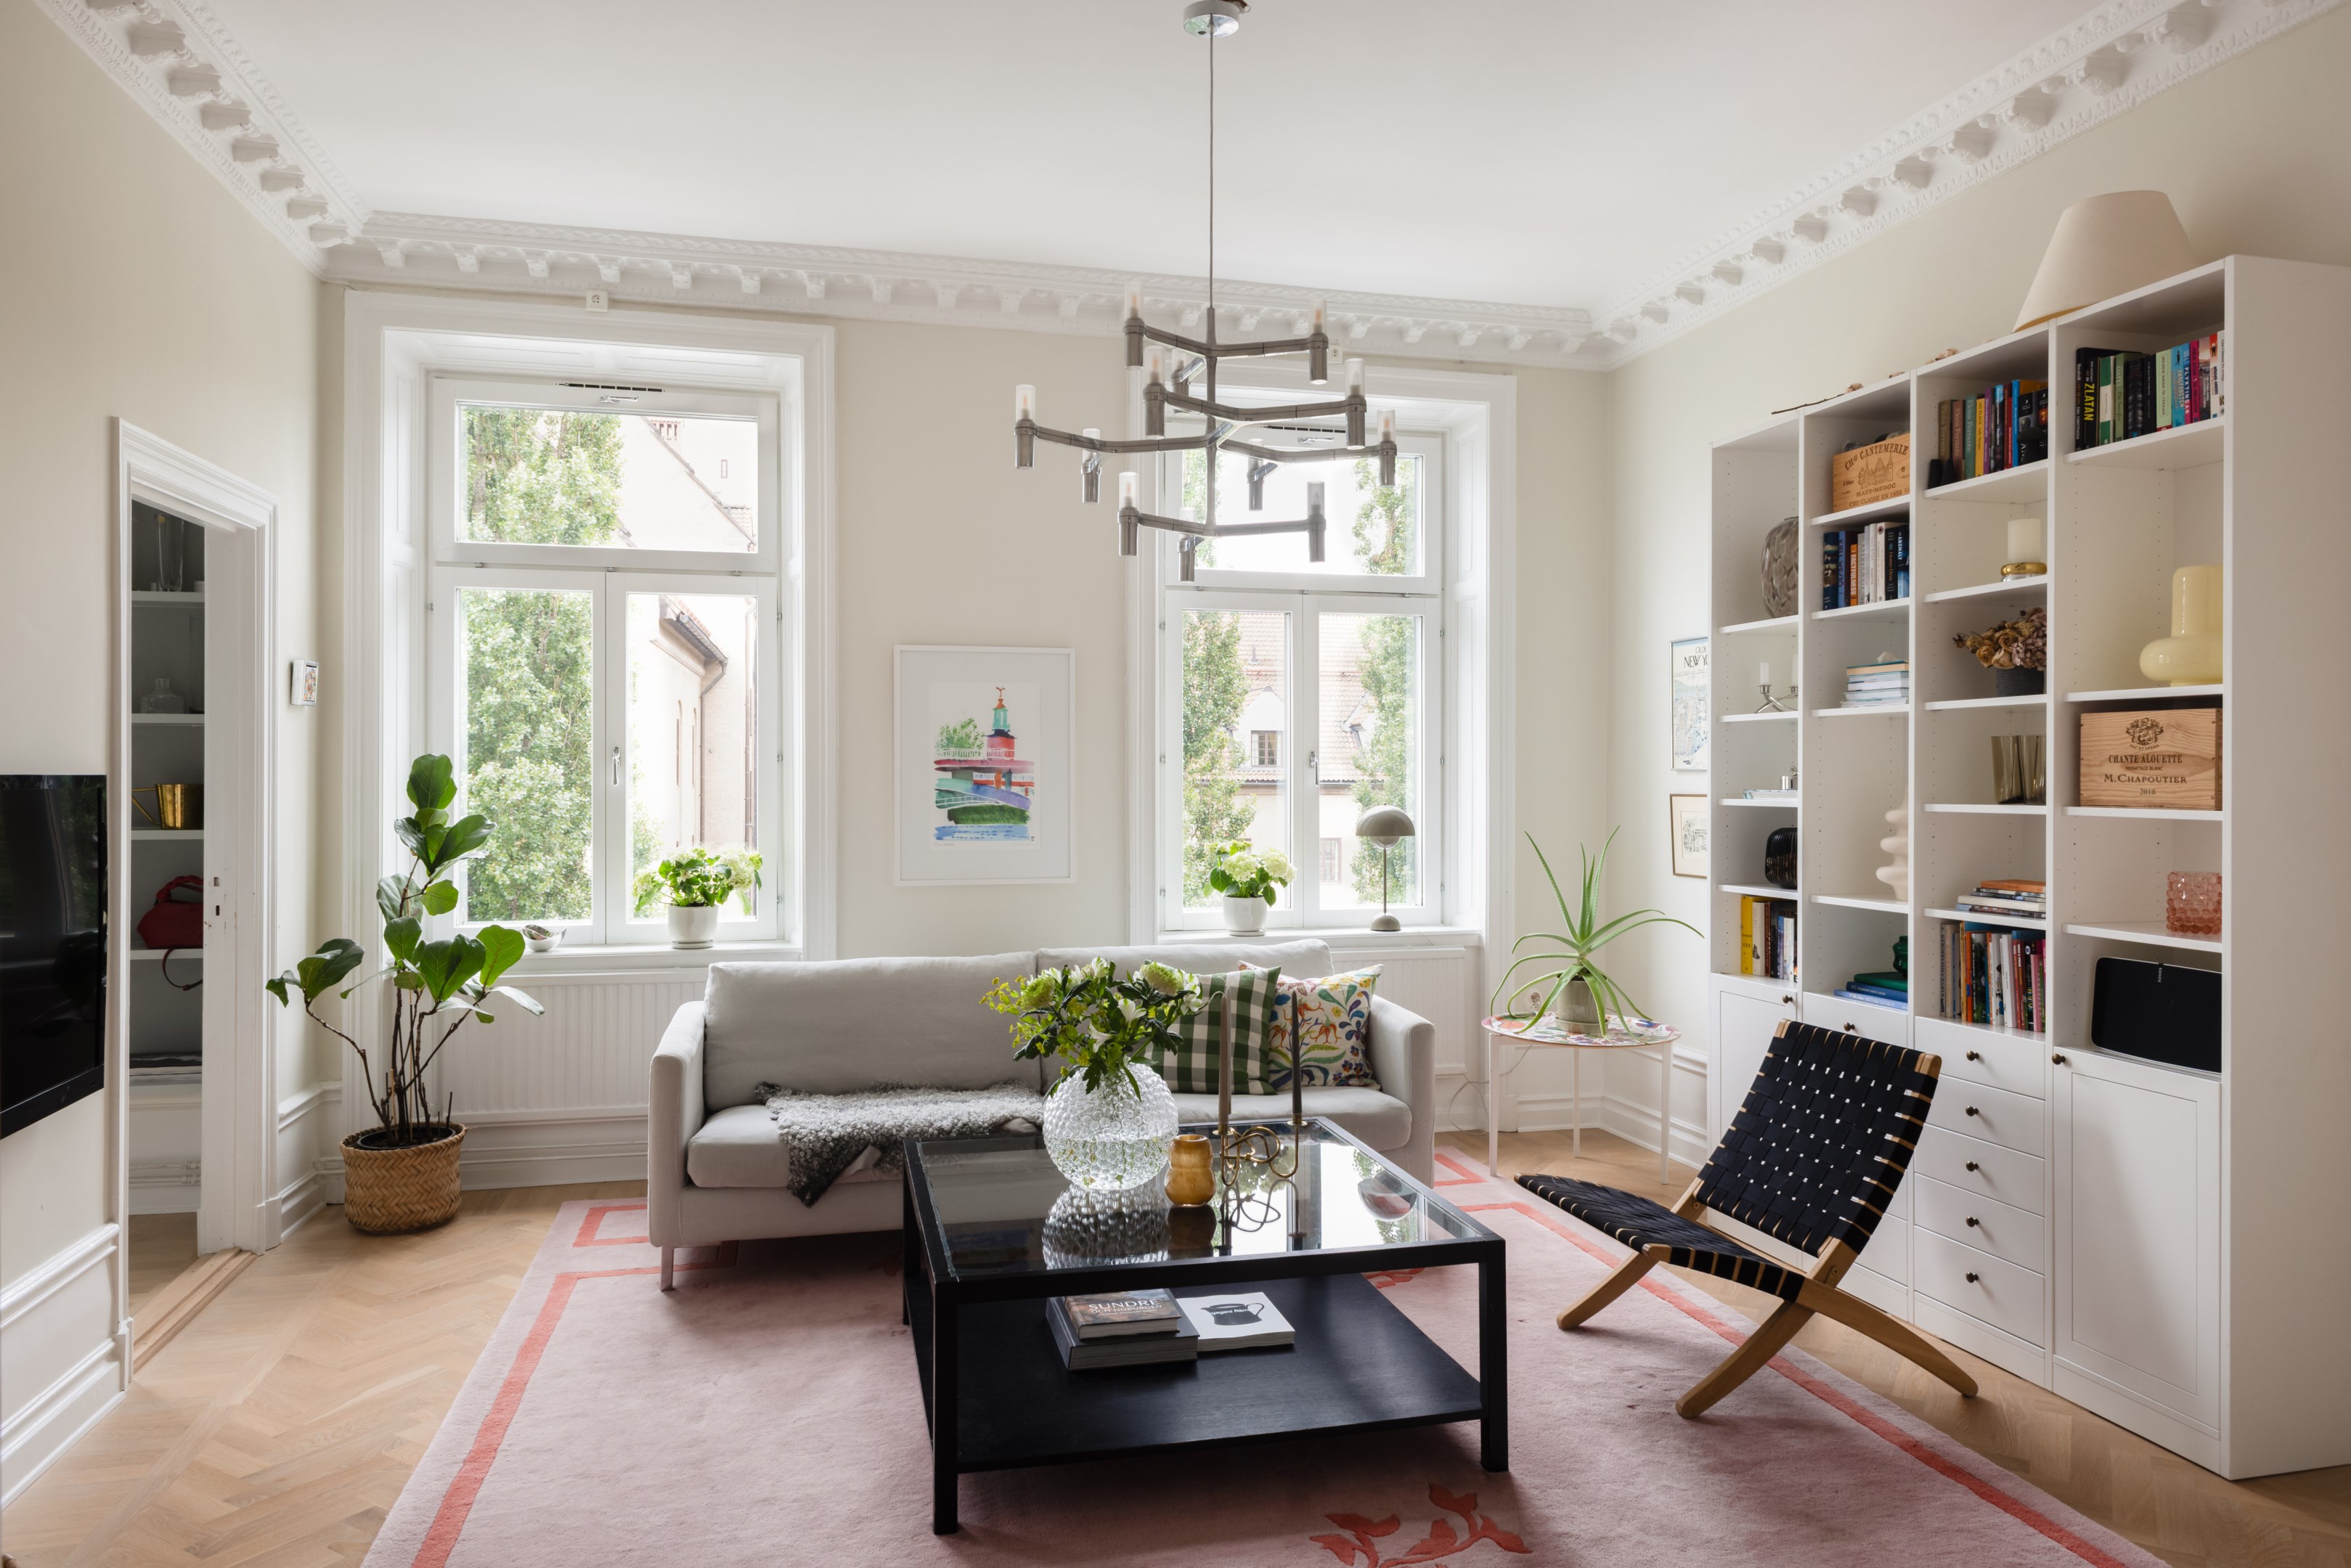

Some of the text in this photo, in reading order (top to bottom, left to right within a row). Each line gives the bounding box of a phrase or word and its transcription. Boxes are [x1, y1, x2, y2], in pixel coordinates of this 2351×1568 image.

[2084, 383, 2095, 421] ZLATAN
[1859, 443, 1909, 460] CANTEMERLE
[1890, 489, 1902, 498] 1855
[1684, 655, 1700, 668] NEW
[2108, 754, 2183, 763] CHANTE ALOUETTE
[1088, 1299, 1160, 1310] SUNDRE
